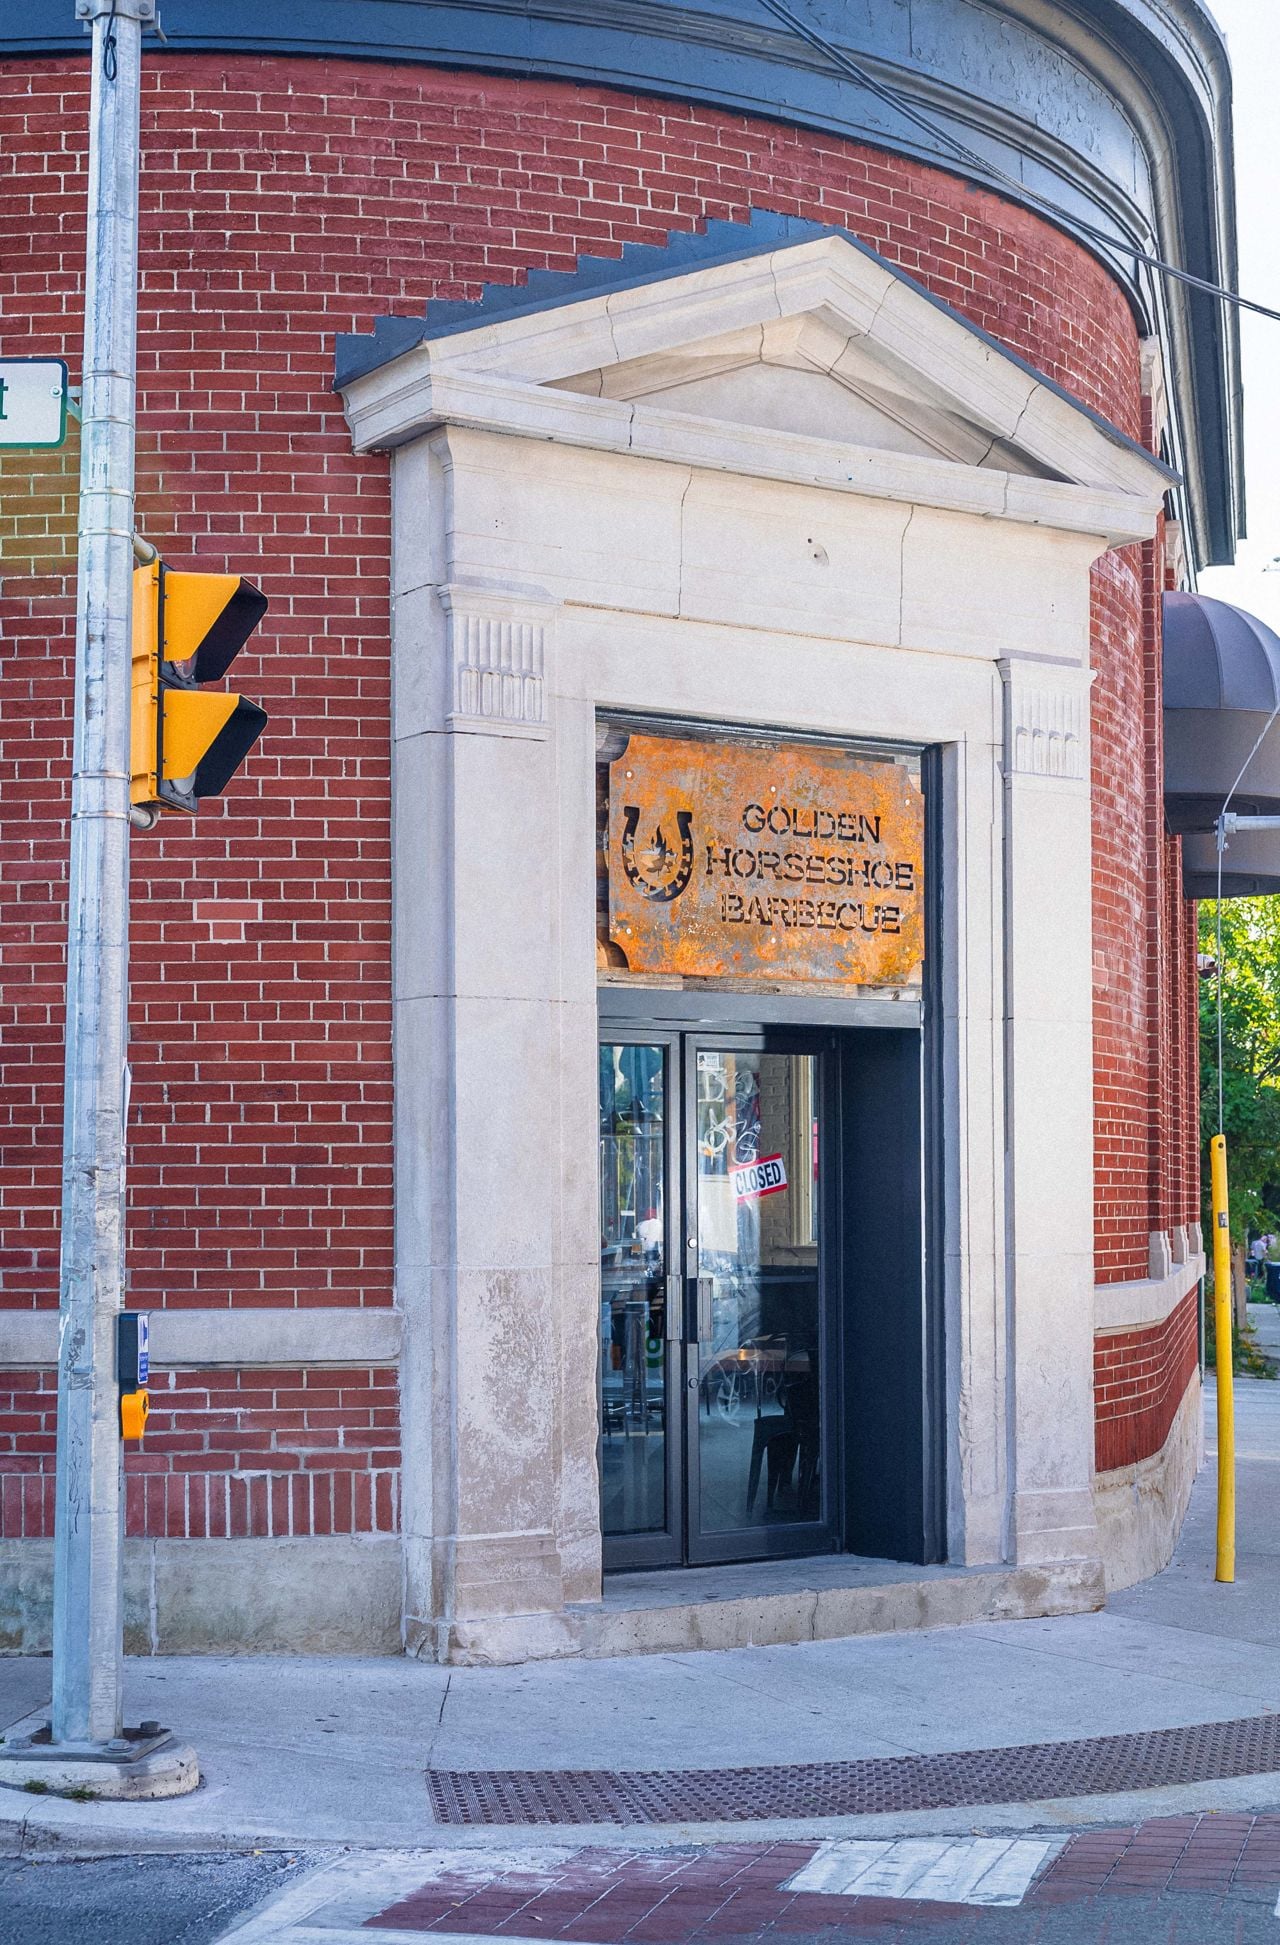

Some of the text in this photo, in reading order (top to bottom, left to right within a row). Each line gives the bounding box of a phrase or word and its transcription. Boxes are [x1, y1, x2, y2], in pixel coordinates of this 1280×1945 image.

[742, 803, 881, 844] GOLDEN
[705, 846, 914, 891] HORSESHOE
[721, 894, 900, 934] BARBECUE
[736, 1162, 782, 1195] CLOSED
